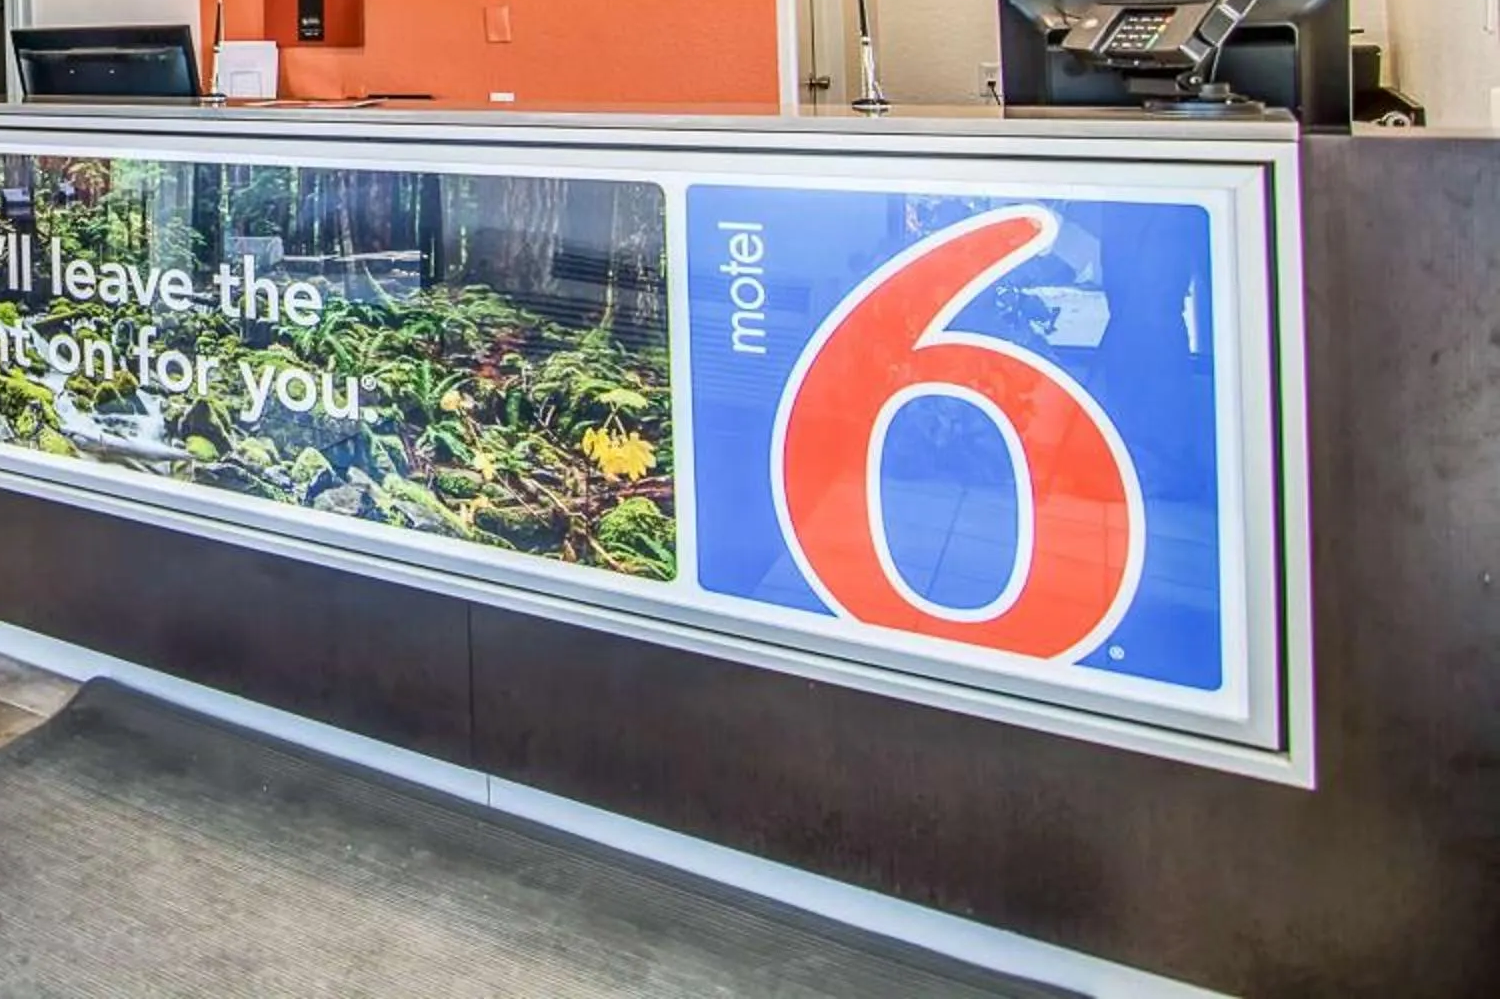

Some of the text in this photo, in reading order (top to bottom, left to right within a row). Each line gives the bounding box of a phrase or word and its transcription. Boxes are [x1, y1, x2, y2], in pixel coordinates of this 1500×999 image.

[51, 236, 194, 311] leave
[213, 254, 324, 326] the
[48, 338, 115, 381] on
[132, 326, 221, 396] for
[718, 204, 1146, 662] motel 6
